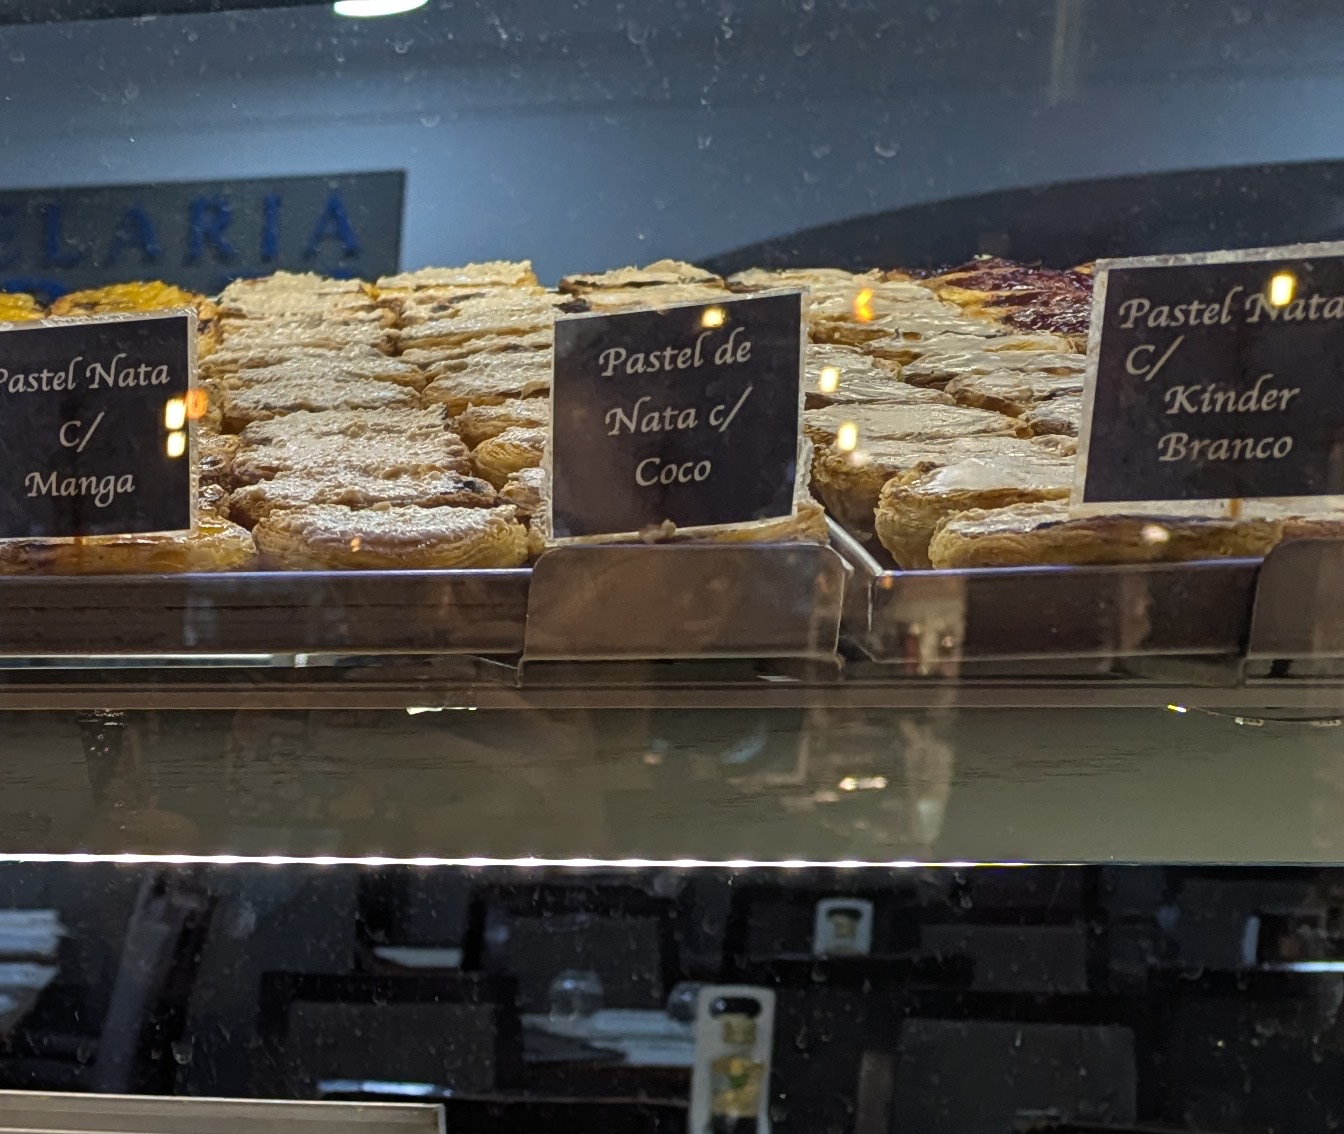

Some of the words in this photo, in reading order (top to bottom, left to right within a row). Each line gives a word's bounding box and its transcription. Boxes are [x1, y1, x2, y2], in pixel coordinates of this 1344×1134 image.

[1118, 285, 1244, 329] Pastel
[1245, 286, 1344, 325] Nata
[86, 353, 171, 389] Nata
[598, 330, 712, 377] Pastel
[714, 326, 752, 365] de
[1125, 334, 1185, 382] C/
[605, 396, 698, 436] Nata
[709, 385, 753, 433] c/
[1165, 373, 1301, 415] Kinder
[59, 411, 105, 453] C/
[1157, 432, 1293, 462] Branco
[24, 471, 136, 508] Manga
[635, 457, 712, 487] Coco
